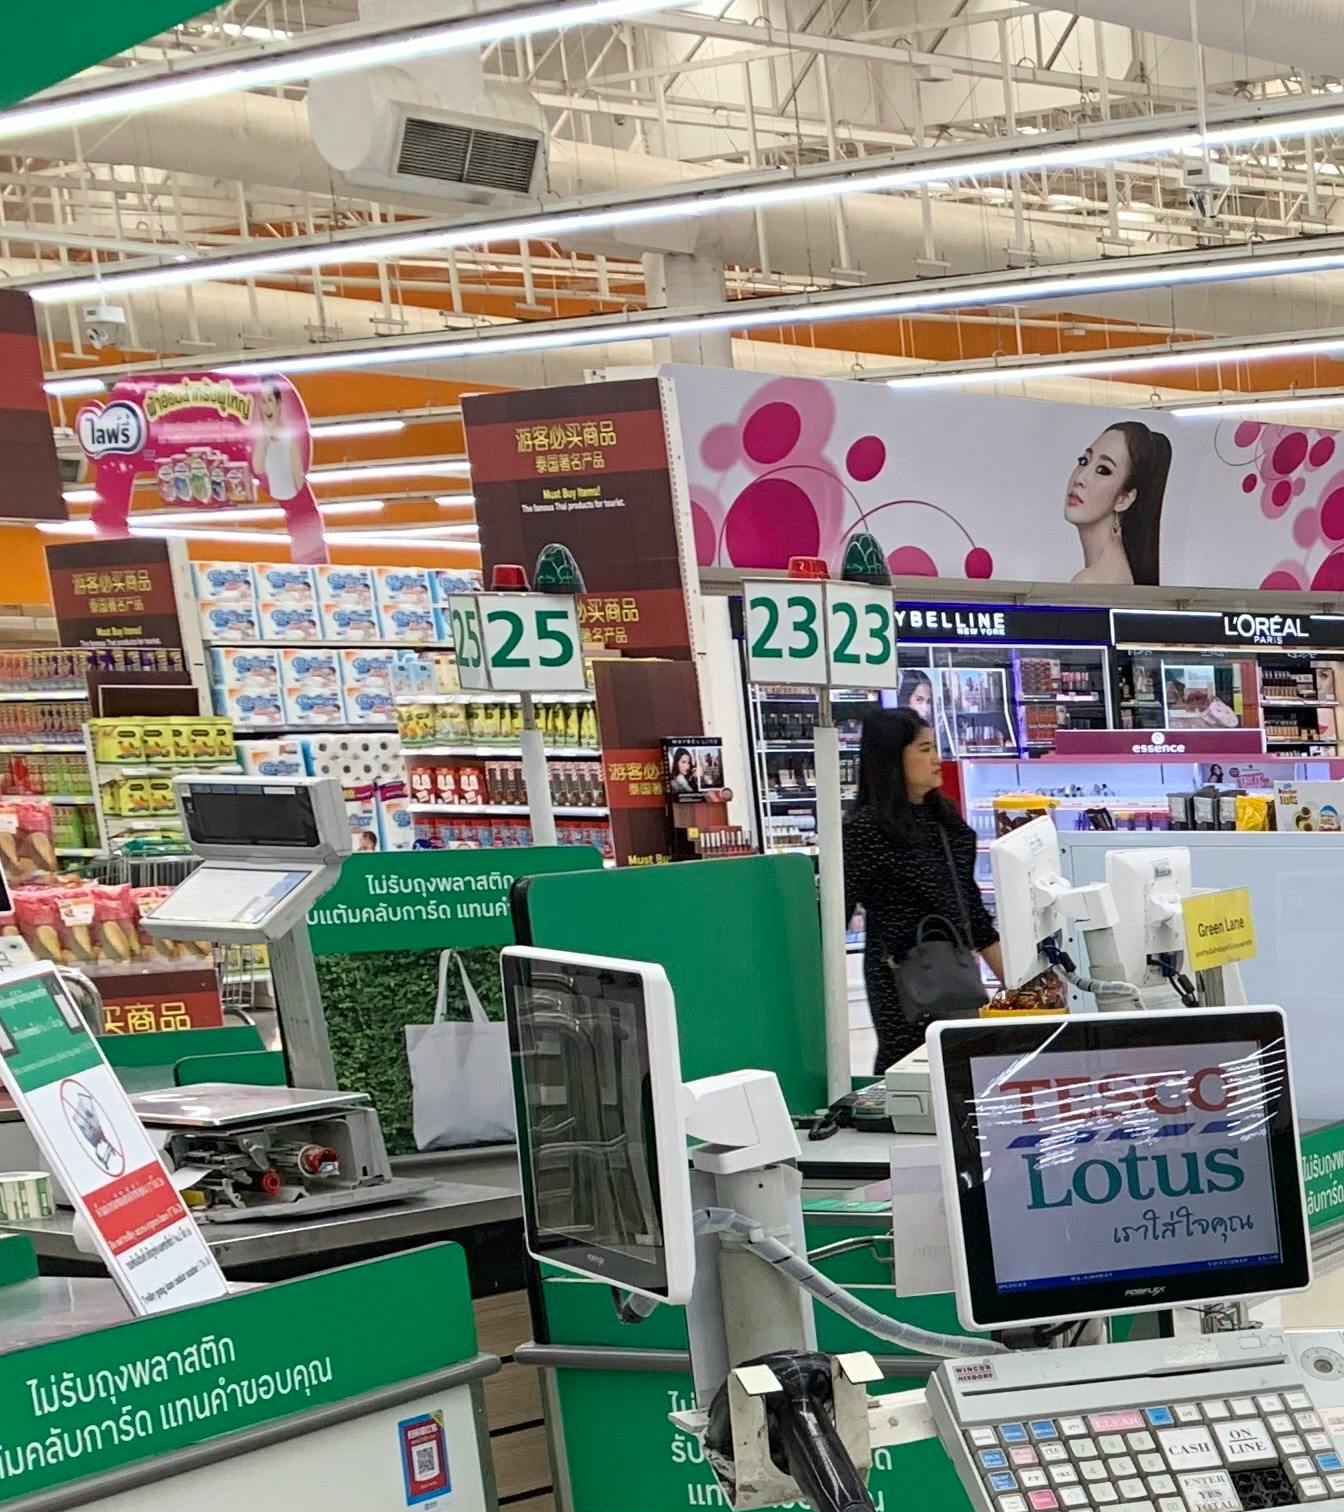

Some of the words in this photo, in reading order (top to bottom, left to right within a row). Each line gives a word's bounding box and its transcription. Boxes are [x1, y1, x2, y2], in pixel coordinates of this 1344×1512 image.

[515, 420, 616, 452] 游客必买商品
[535, 451, 605, 473] 泰国著名产品
[543, 489, 561, 500] Must
[563, 488, 576, 500] Buy
[750, 596, 819, 659] 23
[832, 602, 891, 665] 23
[957, 628, 978, 636] NEW
[980, 628, 1005, 636] YORK
[1224, 613, 1310, 638] L'ORÉAL
[453, 610, 482, 668] 25
[487, 610, 575, 669] 25
[1253, 635, 1283, 645] PARIS
[1132, 744, 1185, 753] essence
[1197, 922, 1224, 937] Green
[1225, 917, 1244, 932] Lane
[999, 1066, 1238, 1125] TESCO
[1021, 1145, 1245, 1210] Lotus
[1114, 1206, 1255, 1243] เราใส่ใจคุณ
[26, 1334, 236, 1417] ไม่รับถุงพลาสติก
[955, 1364, 992, 1374] WINCOR
[958, 1373, 993, 1382] NIXDORF
[161, 1356, 333, 1431] แทนคำขอบคุณ
[1229, 1427, 1252, 1440] ON
[1169, 1442, 1210, 1456] CASH
[1229, 1442, 1266, 1455] LINE
[1184, 1475, 1226, 1487] ENTER
[1198, 1490, 1222, 1500] YES
[1193, 1500, 1239, 1512] TOTAL
